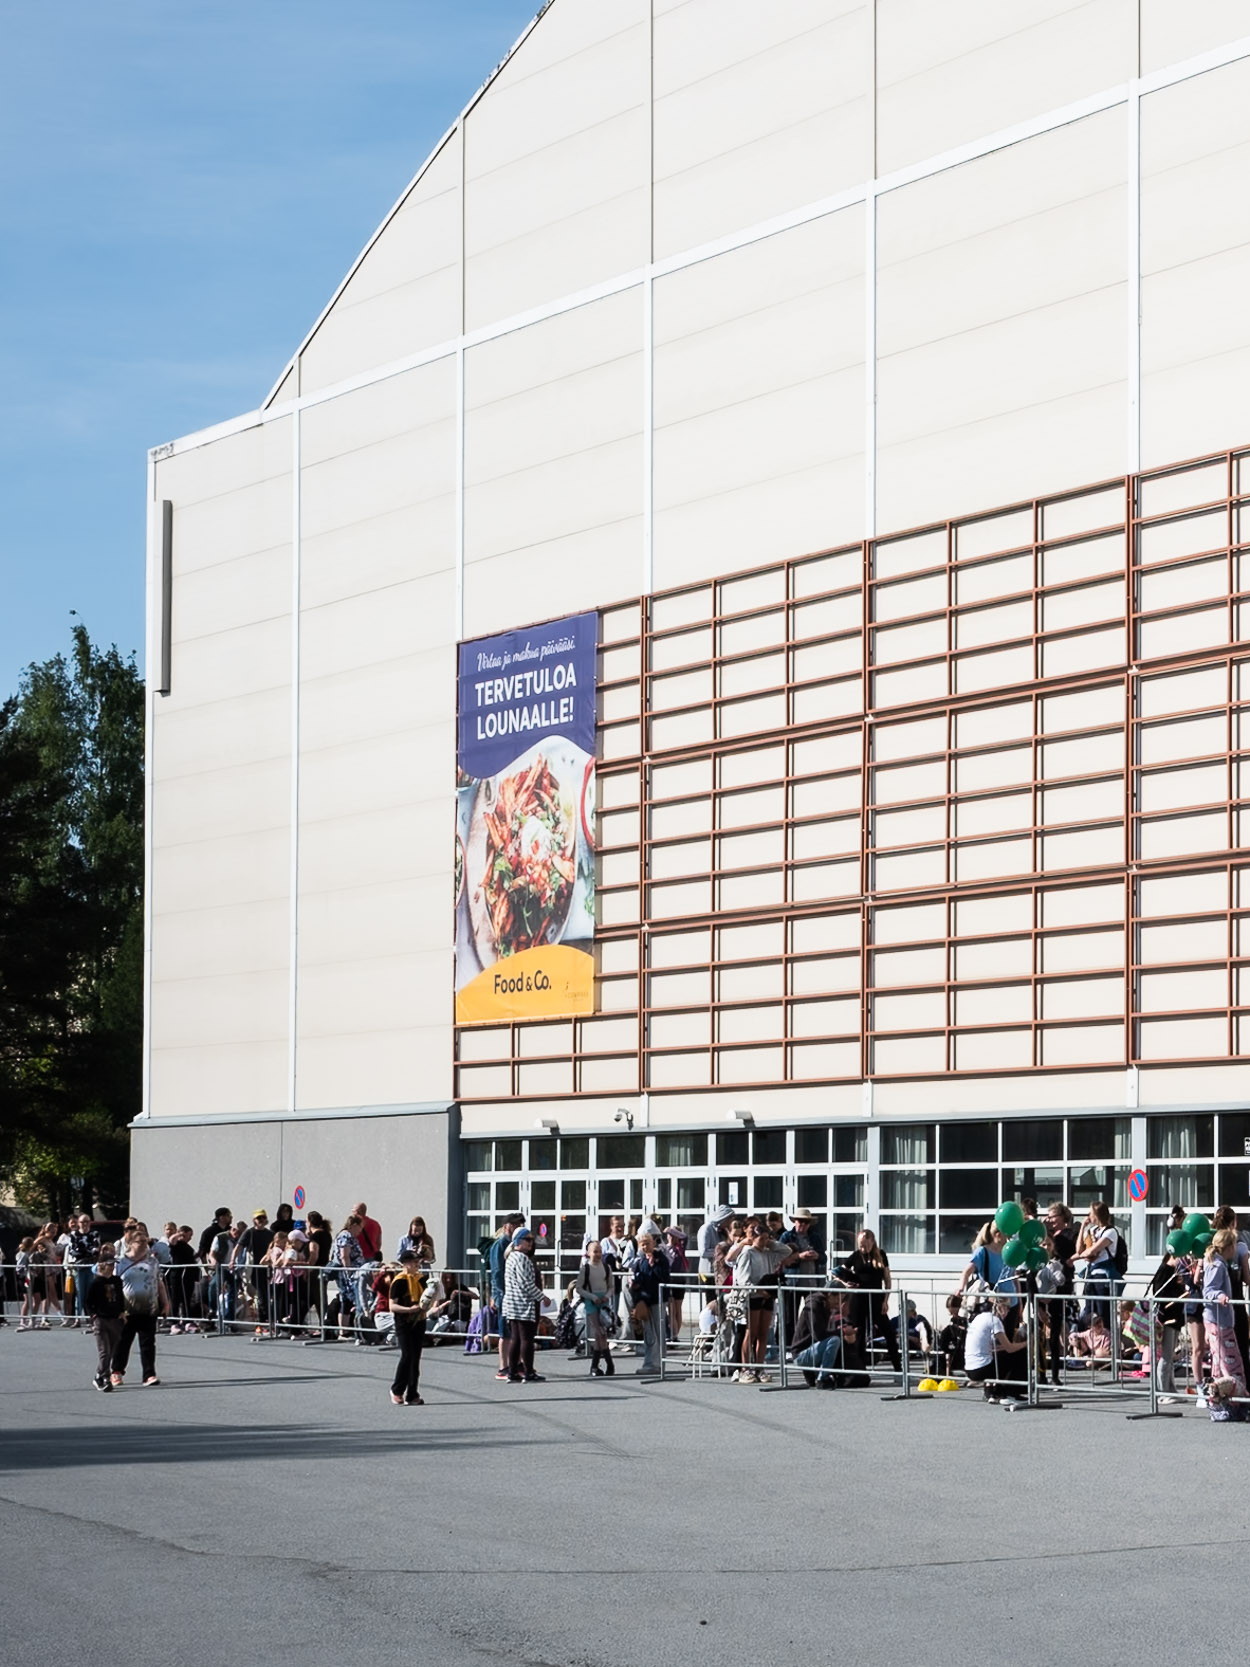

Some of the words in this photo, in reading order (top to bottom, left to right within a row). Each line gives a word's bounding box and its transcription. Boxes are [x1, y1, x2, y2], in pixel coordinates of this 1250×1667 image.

[501, 650, 512, 671] ja
[512, 641, 540, 663] makua
[475, 662, 577, 707] TERVETULOA
[477, 696, 574, 741] LOUNAALLE!
[494, 971, 524, 995] Food
